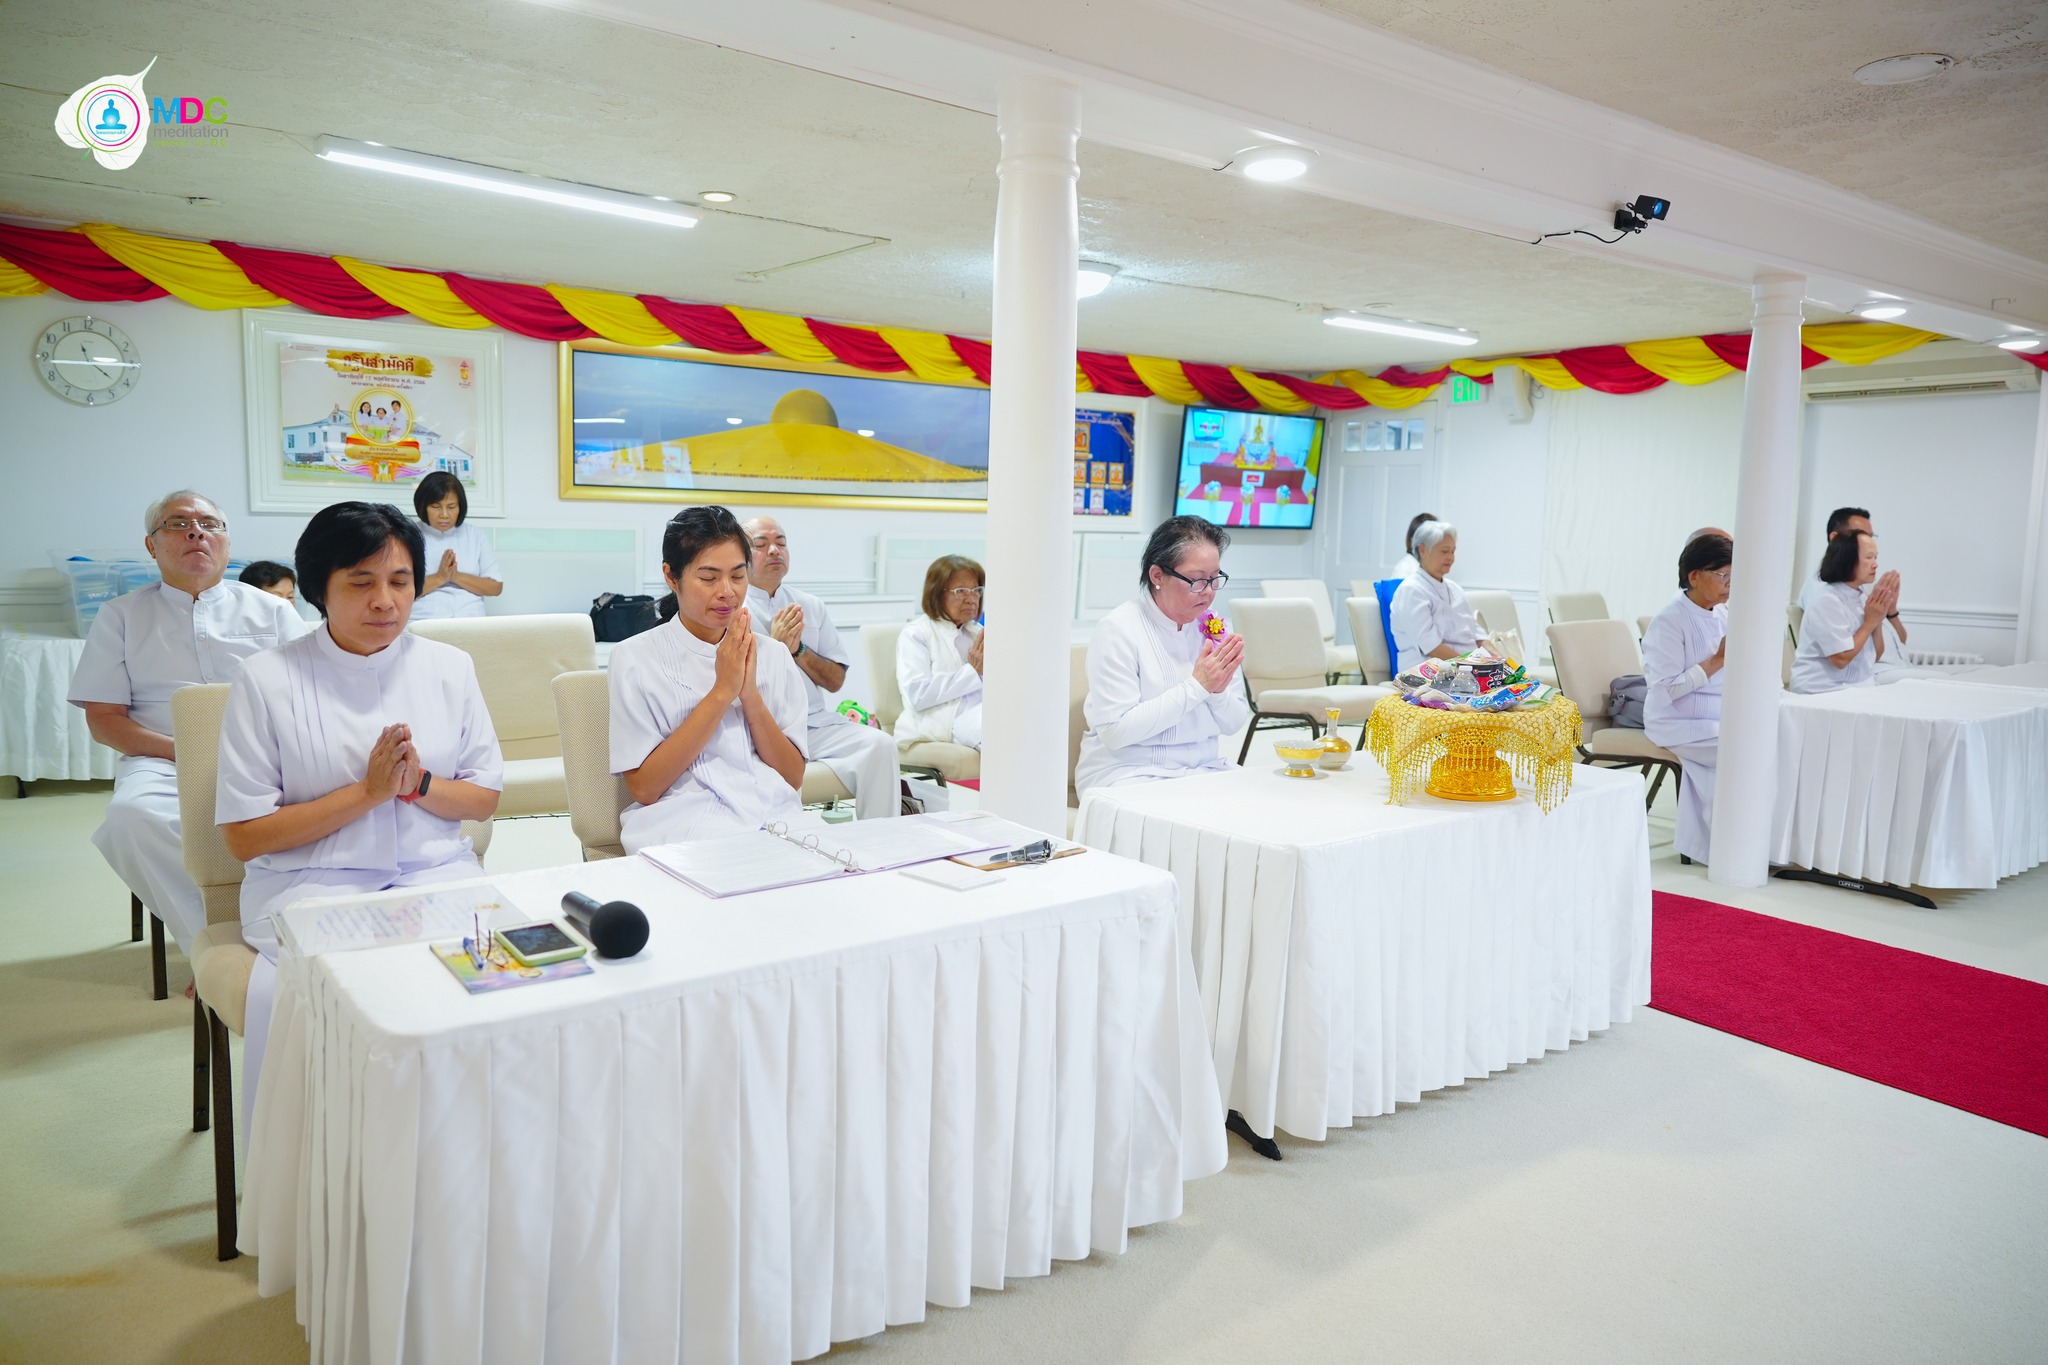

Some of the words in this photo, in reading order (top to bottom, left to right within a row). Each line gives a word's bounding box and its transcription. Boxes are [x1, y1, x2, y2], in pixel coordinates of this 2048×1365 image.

[63, 321, 71, 332] 11
[84, 320, 93, 331] 12
[108, 326, 112, 337] 1
[46, 333, 56, 344] 10
[123, 341, 129, 352] 2
[42, 351, 49, 362] 9
[343, 352, 414, 372] กฐินสามัคคี
[48, 371, 55, 381] 8
[123, 378, 130, 387] 4
[64, 385, 71, 395] 7
[108, 389, 115, 399] 5
[87, 392, 94, 402] 6
